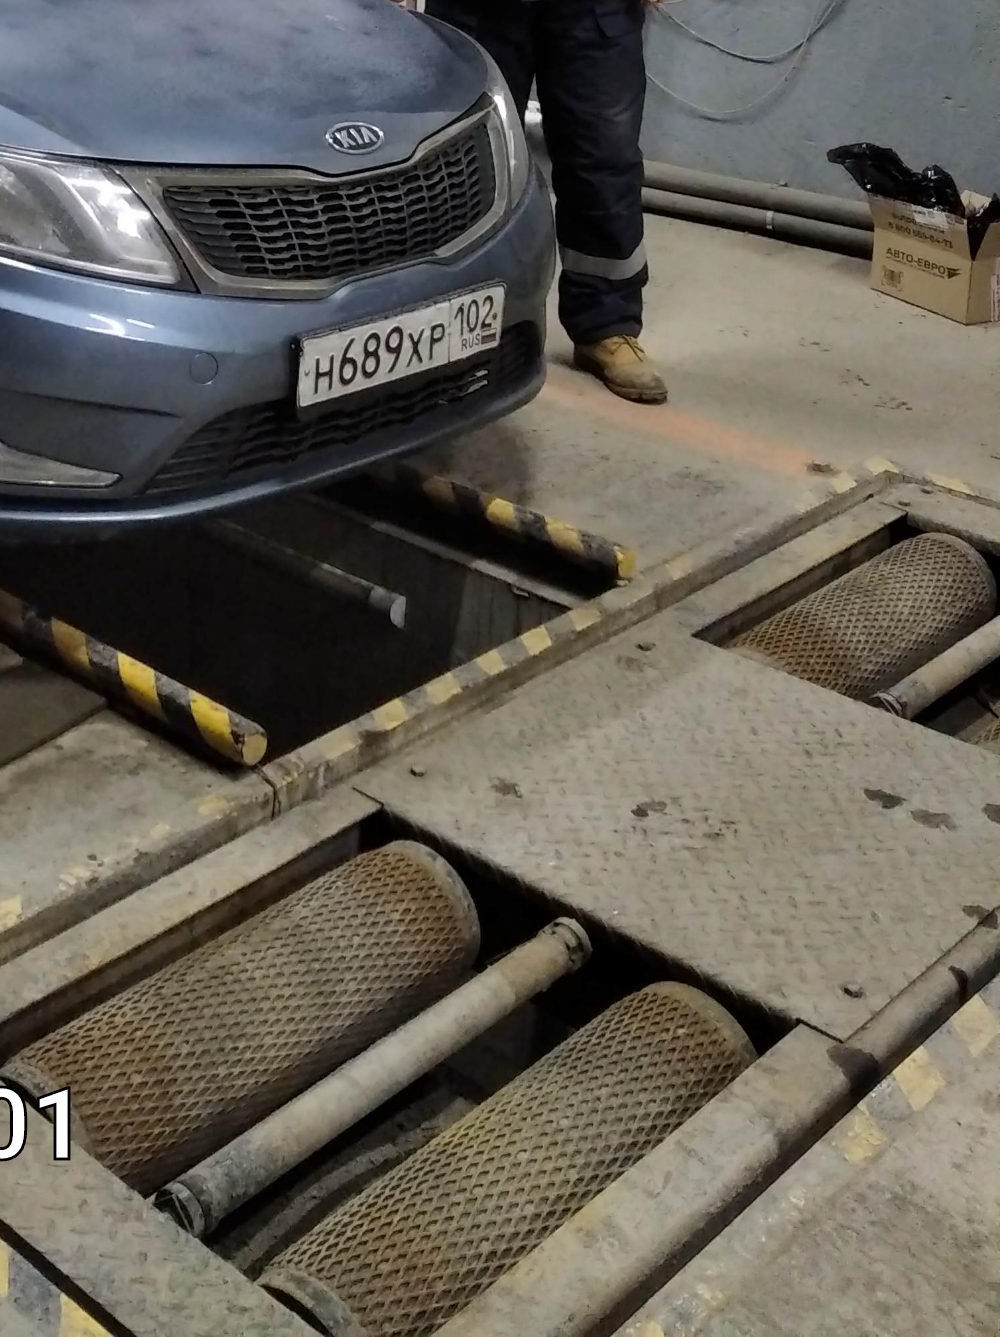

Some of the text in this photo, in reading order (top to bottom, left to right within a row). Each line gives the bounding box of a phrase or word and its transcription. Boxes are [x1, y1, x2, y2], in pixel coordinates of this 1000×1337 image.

[333, 126, 379, 149] KIA
[886, 247, 946, 276] АВТО-ЕВРО
[313, 294, 494, 395] Н689ХР 102
[461, 333, 481, 352] RUS
